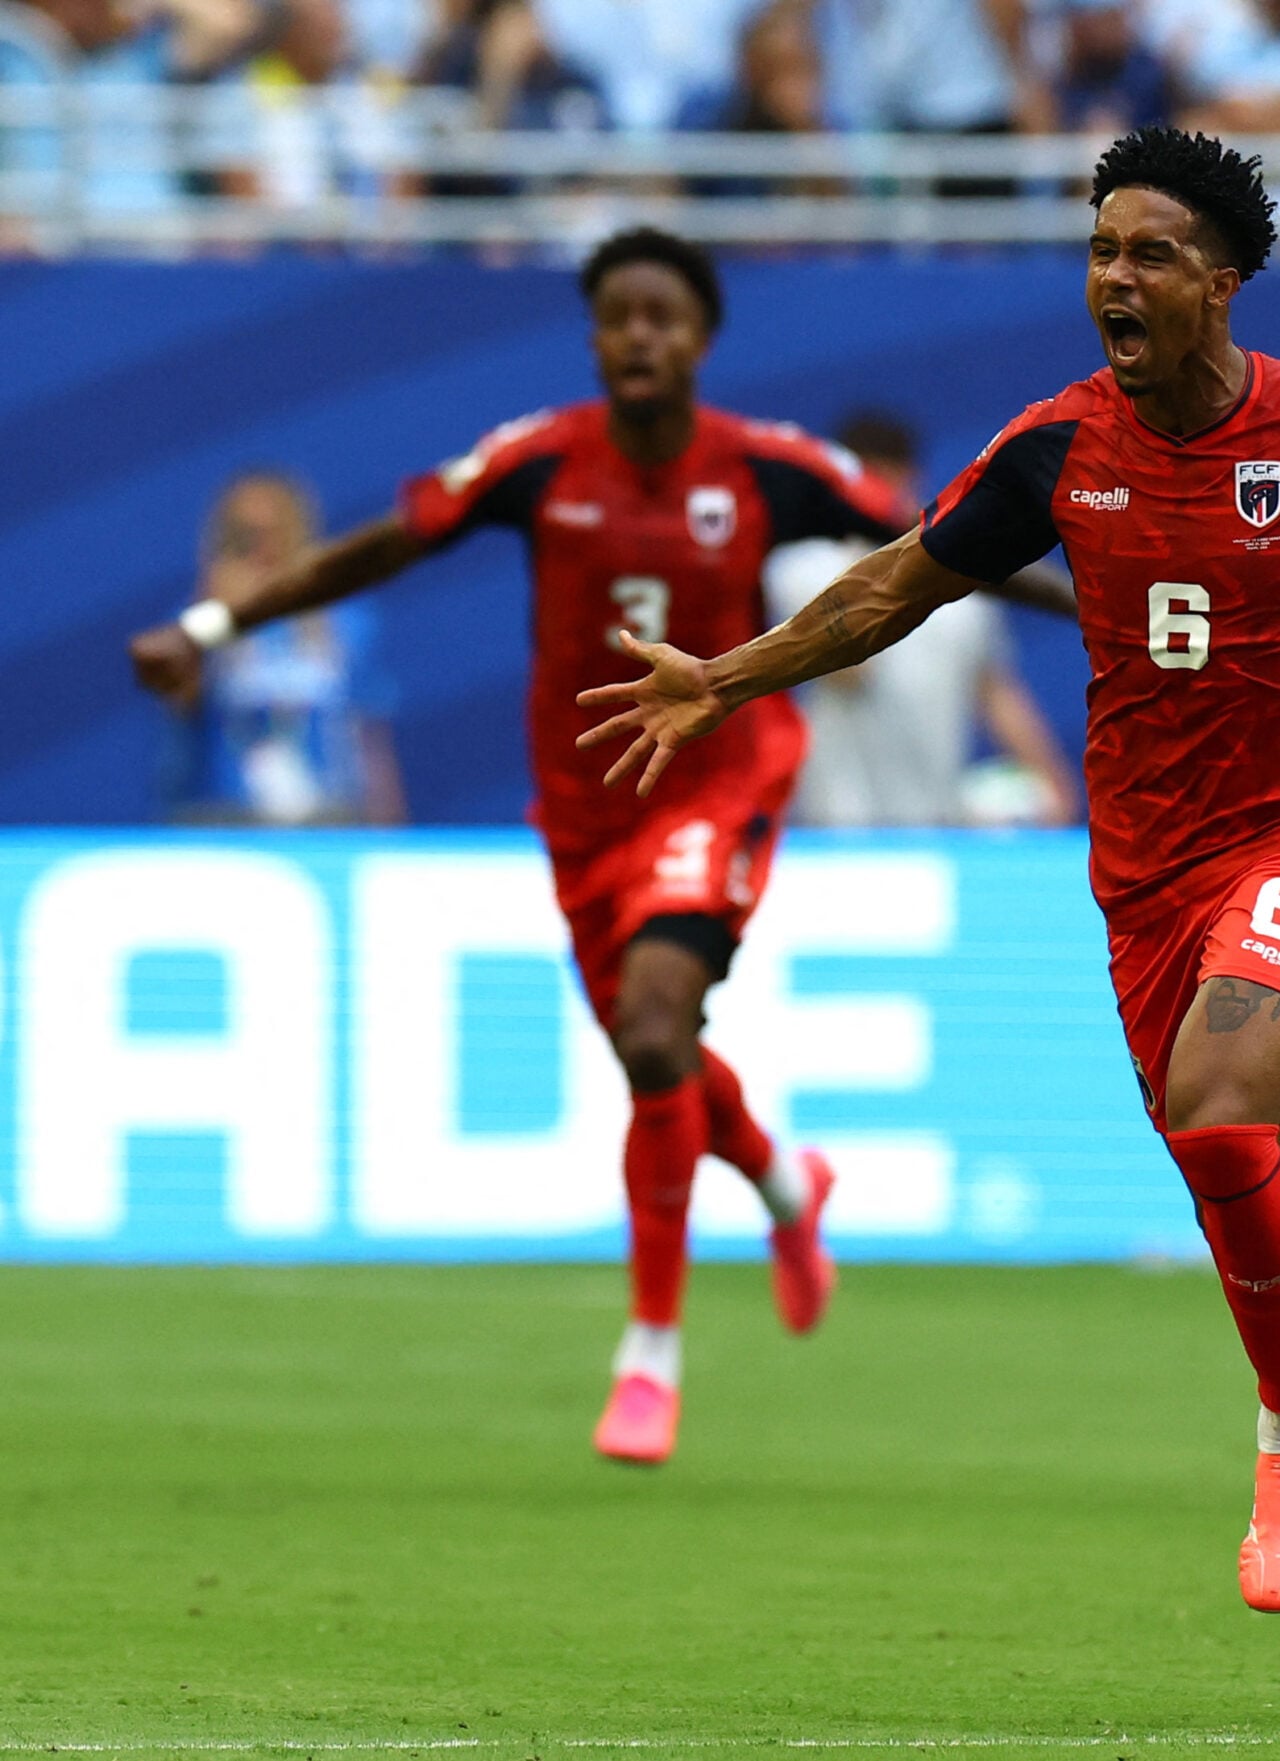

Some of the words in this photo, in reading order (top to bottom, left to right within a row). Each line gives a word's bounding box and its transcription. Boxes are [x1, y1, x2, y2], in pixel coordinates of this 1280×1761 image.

[1239, 464, 1279, 475] FCF
[1070, 487, 1130, 508] capelli
[1095, 503, 1128, 511] SPORT
[605, 576, 669, 650] 3
[1148, 582, 1210, 670] 6
[0, 846, 958, 1240] ADE
